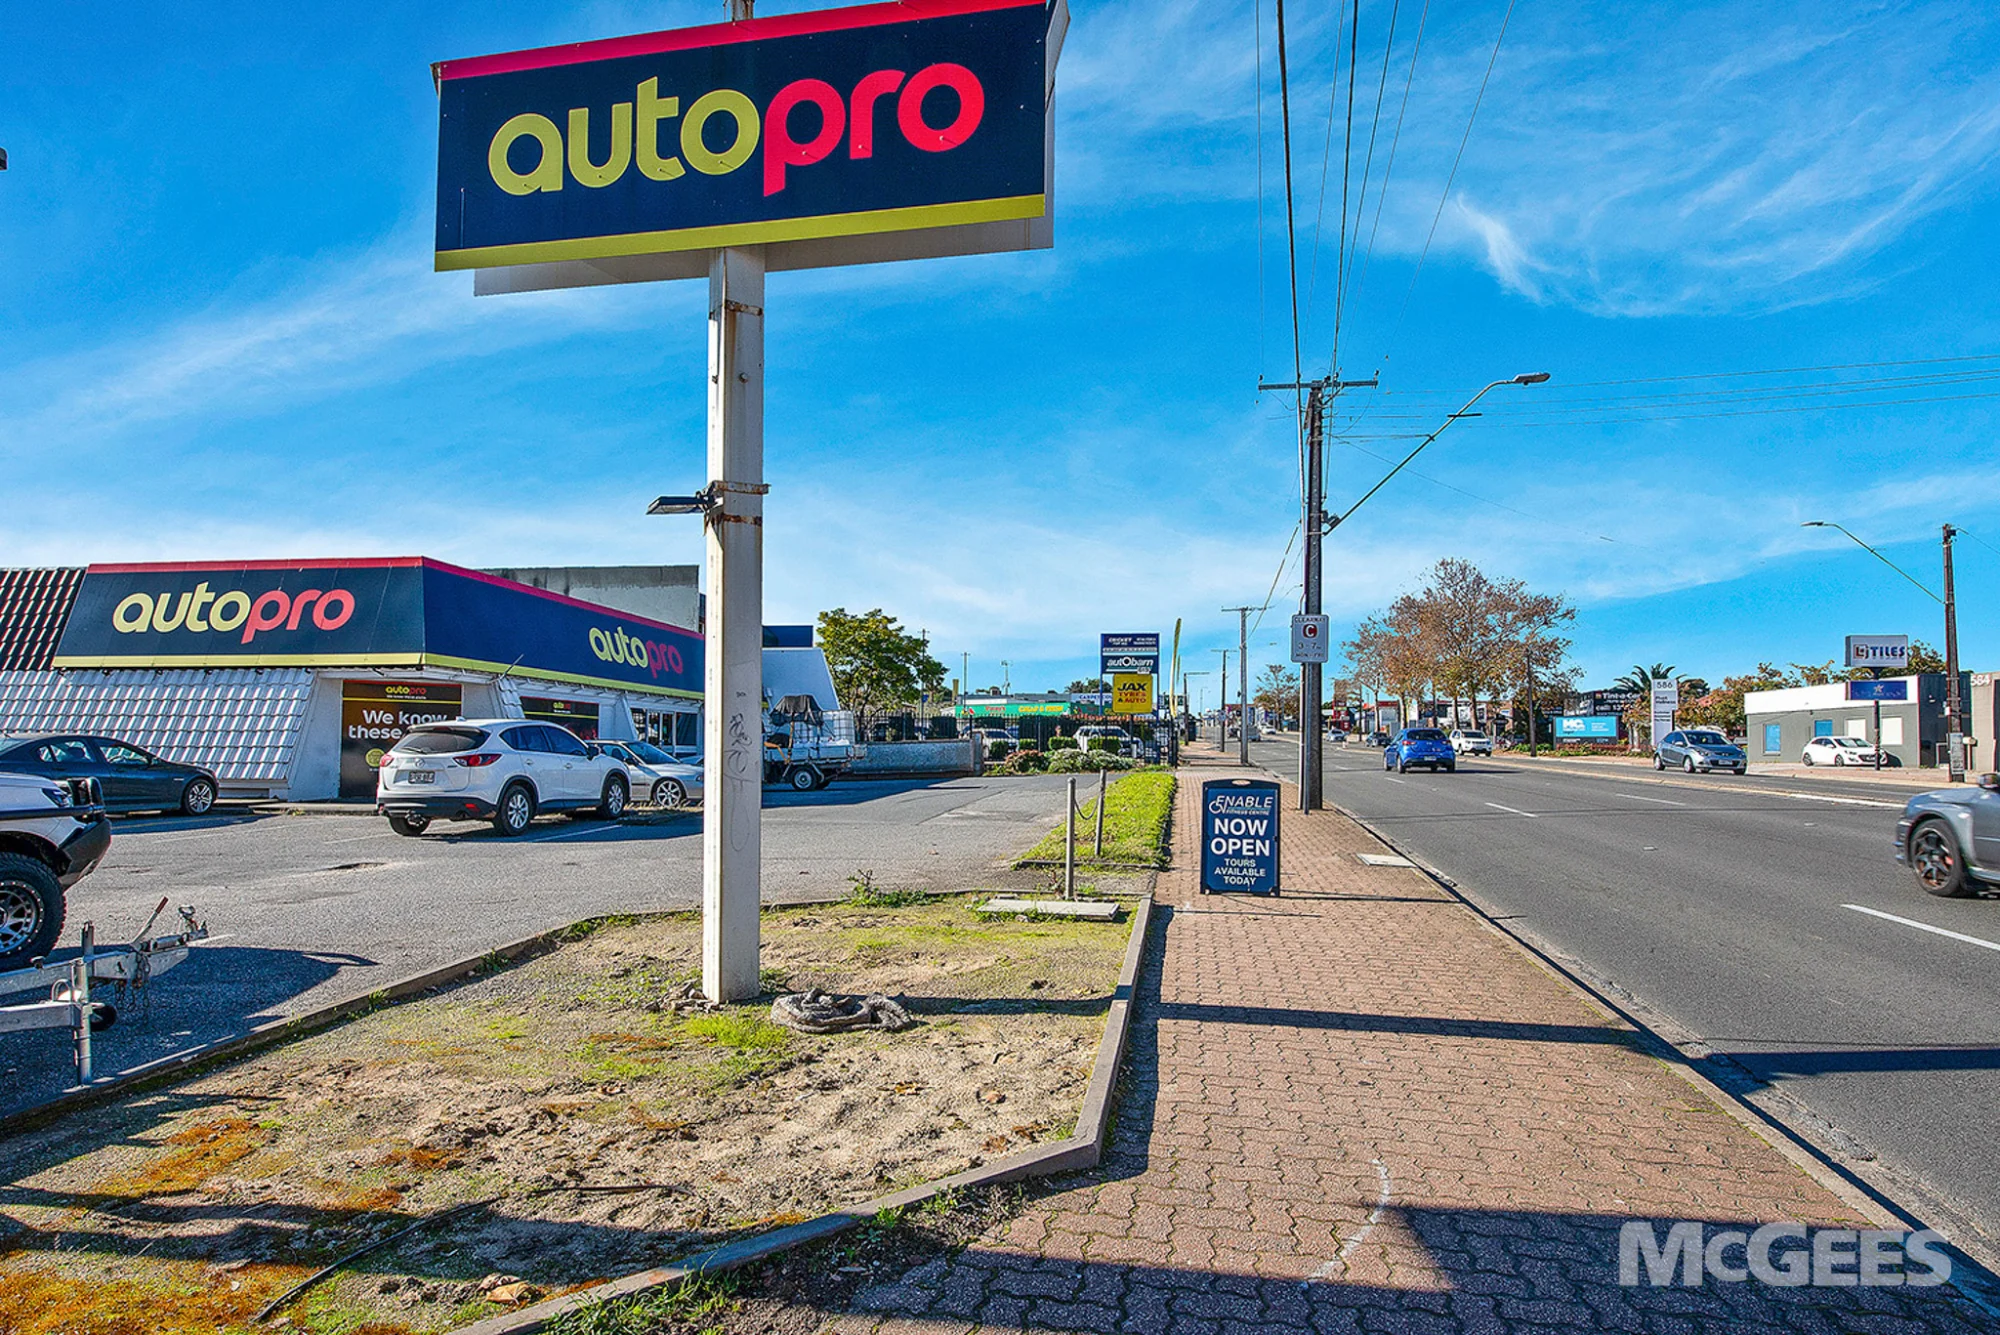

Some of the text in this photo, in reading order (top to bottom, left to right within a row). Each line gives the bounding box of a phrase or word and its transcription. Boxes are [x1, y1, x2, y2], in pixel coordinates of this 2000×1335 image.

[488, 62, 986, 198] autopro
[112, 581, 356, 645] autopro
[1306, 625, 1314, 637] C
[588, 626, 684, 678] autopro
[1870, 646, 1905, 657] TILES
[385, 685, 427, 695] autopro
[1117, 682, 1147, 691] JAX
[1656, 681, 1673, 689] 586
[363, 709, 394, 724] We
[348, 725, 402, 740] these
[1214, 818, 1268, 836] NOW
[1211, 838, 1270, 857] OPEN
[1224, 858, 1256, 867] TOURS
[1214, 867, 1266, 877] AVAILABLE
[1224, 876, 1256, 886] TODAY
